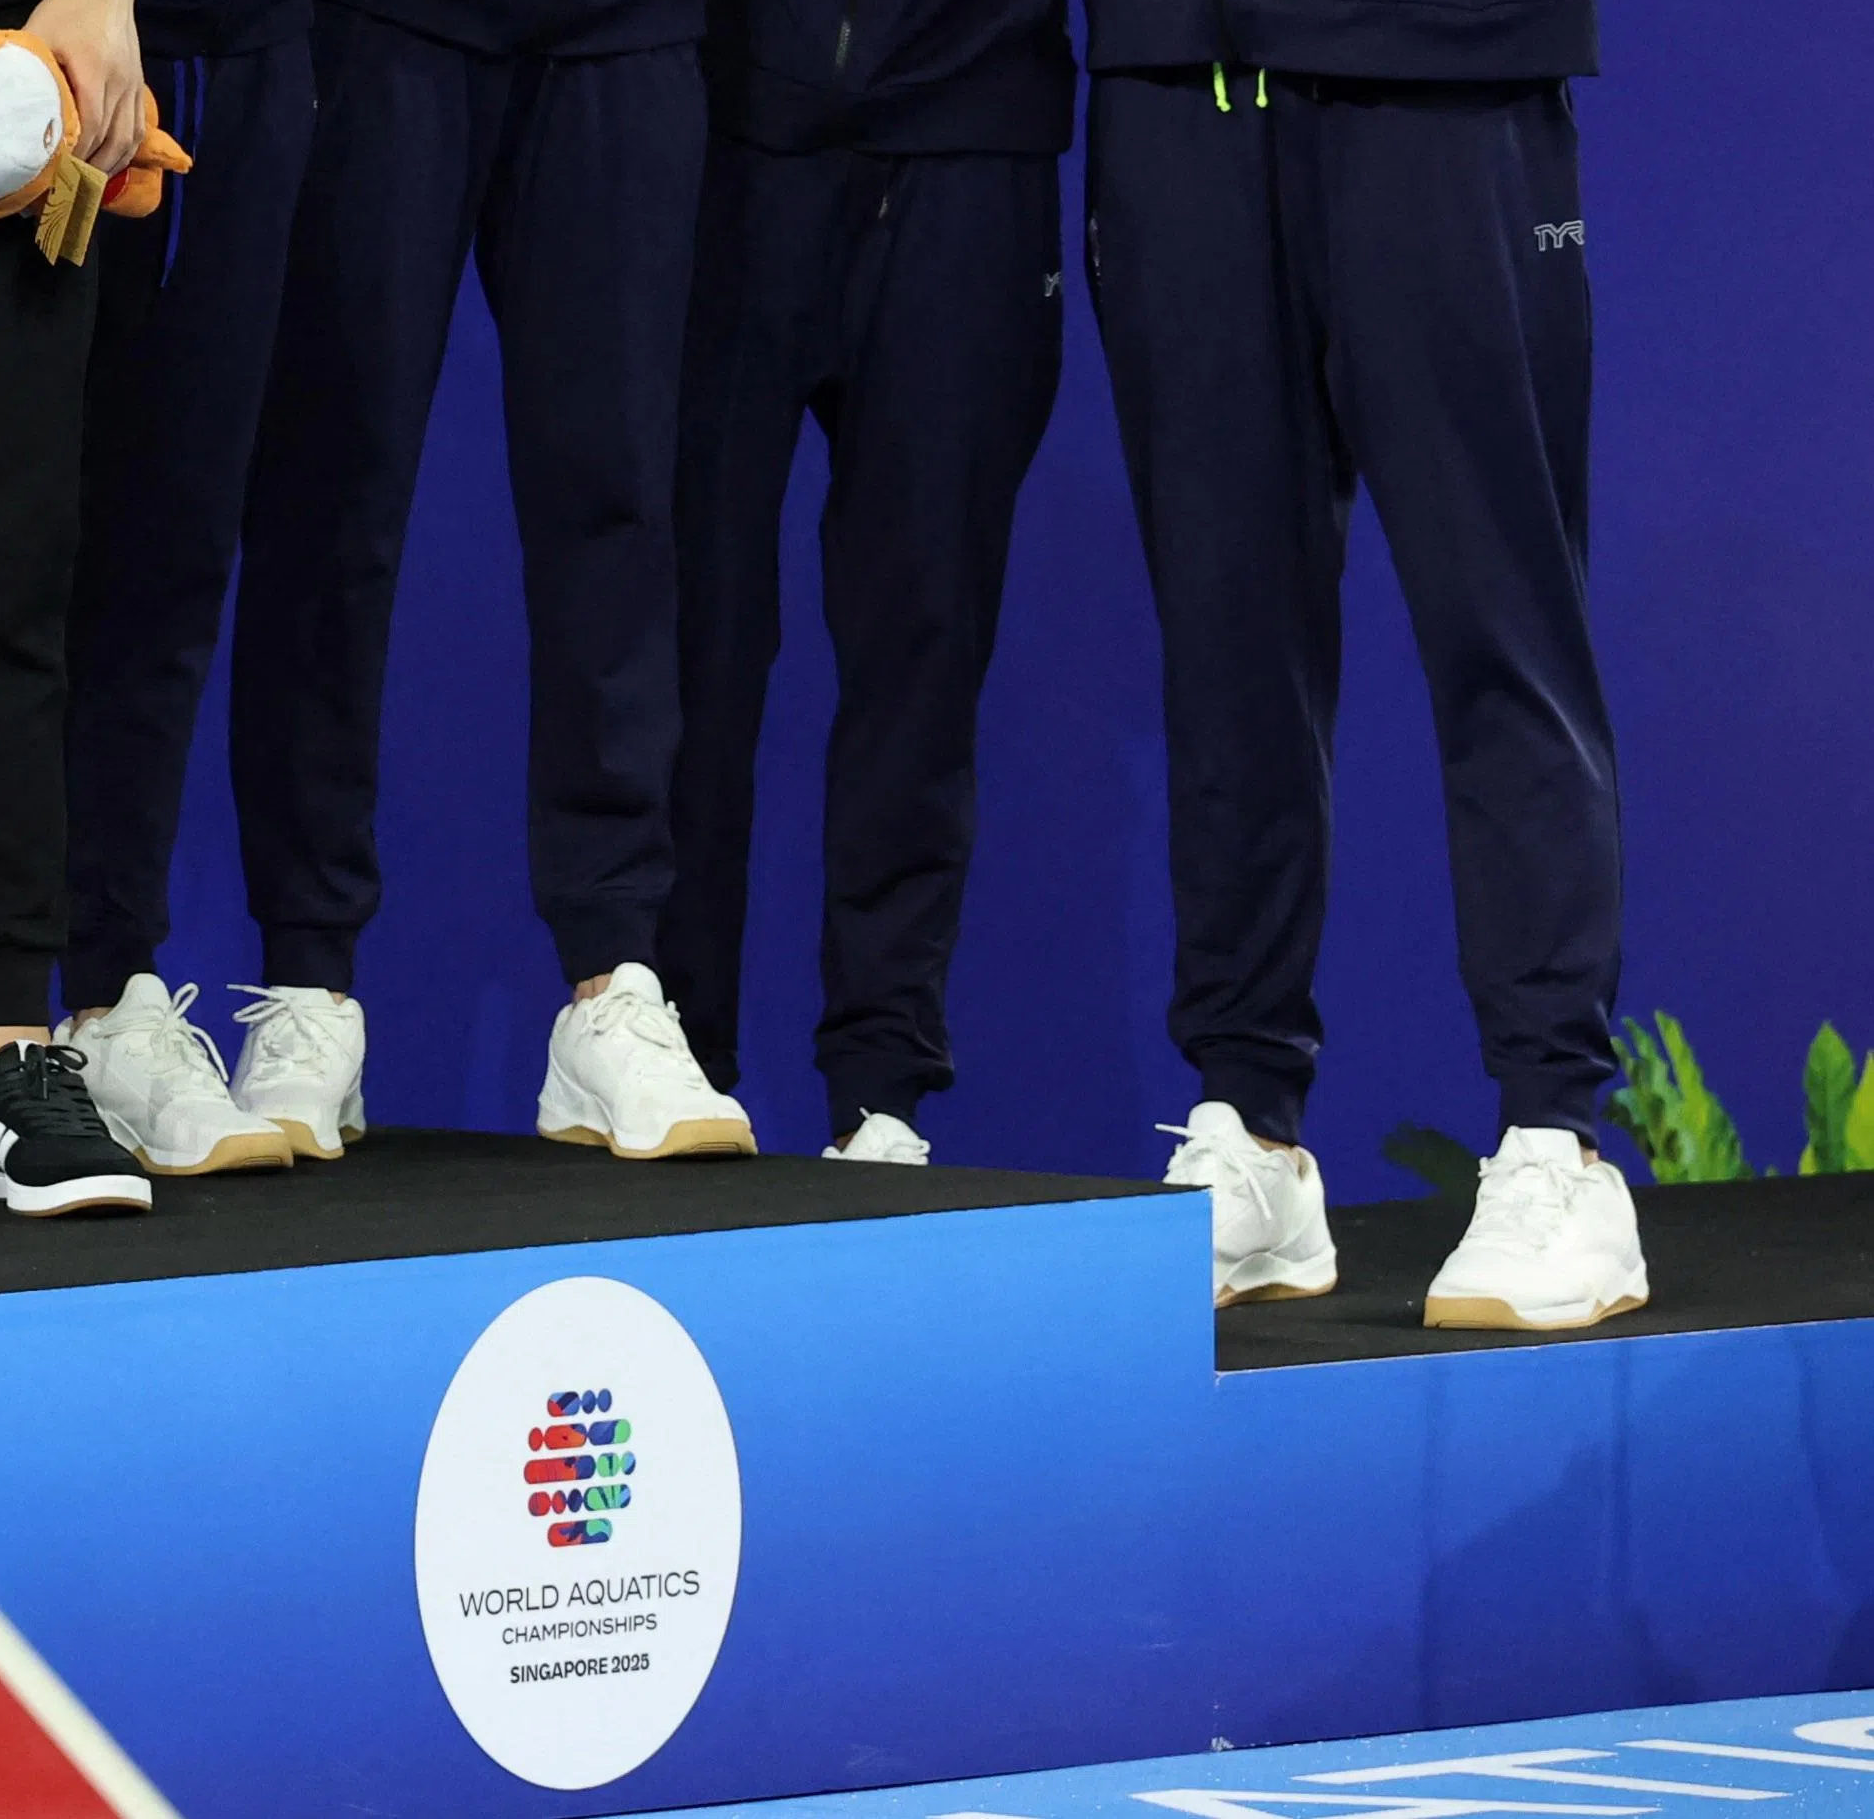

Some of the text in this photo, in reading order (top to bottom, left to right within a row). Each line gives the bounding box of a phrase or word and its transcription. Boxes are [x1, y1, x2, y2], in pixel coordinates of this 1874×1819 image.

[459, 1569, 700, 1618] WORLD AQUATICS
[502, 1613, 658, 1645] CHAMPIONSHIPS
[510, 1652, 650, 1684] SINGAPORE 2025
